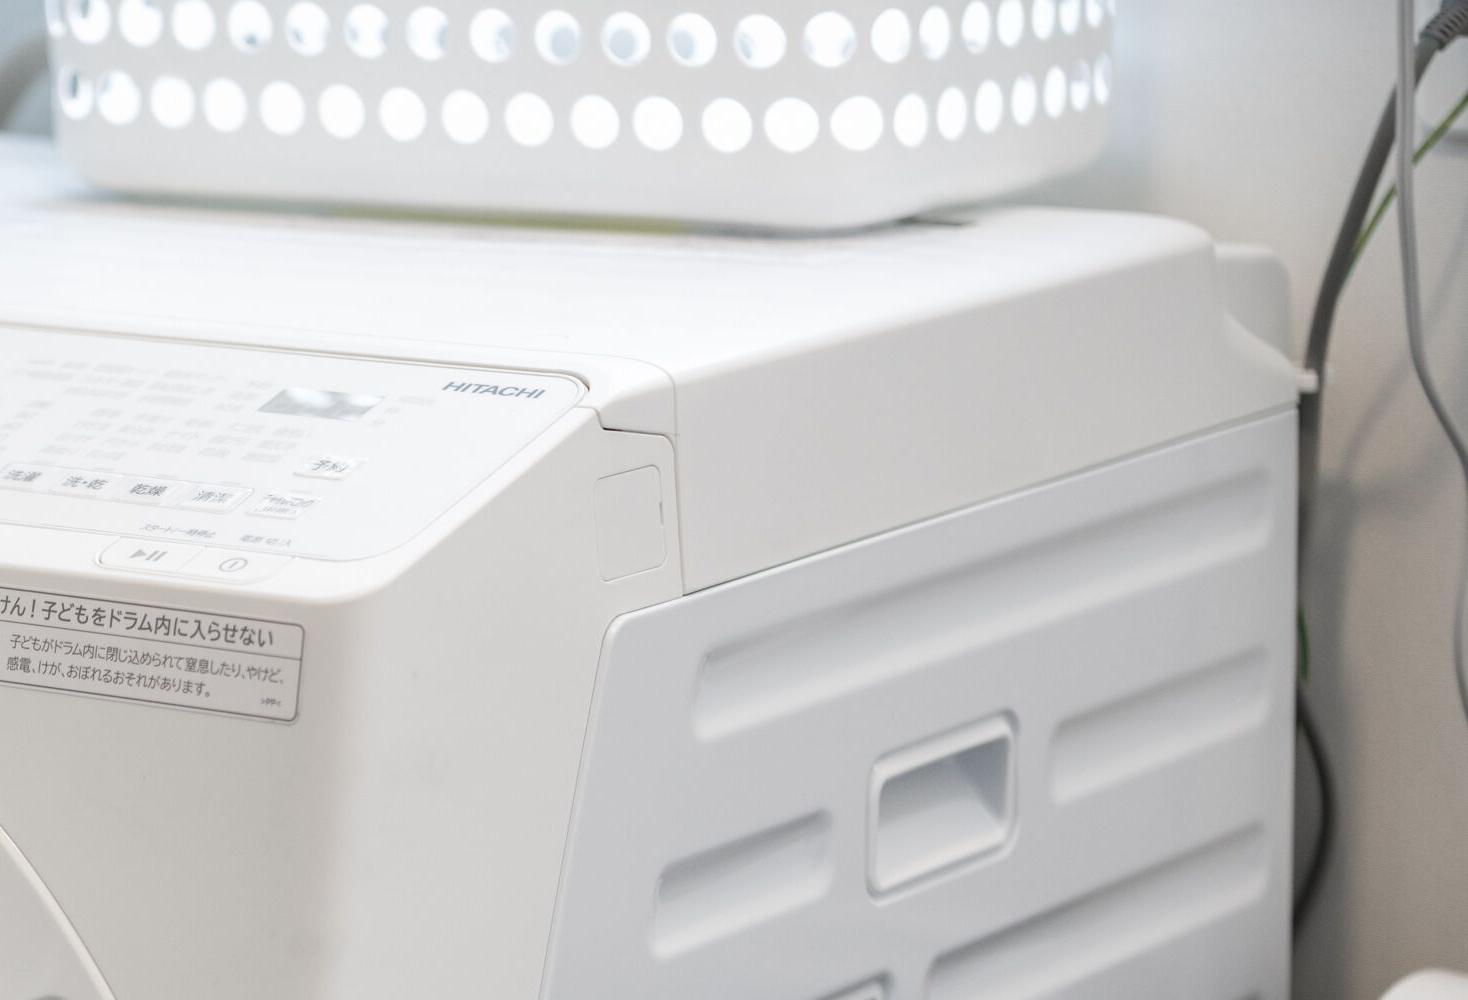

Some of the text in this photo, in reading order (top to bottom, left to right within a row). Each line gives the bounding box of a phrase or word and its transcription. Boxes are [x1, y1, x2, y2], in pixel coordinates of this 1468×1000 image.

[442, 381, 546, 399] HITACHI
[6, 656, 211, 698] 感電、けが、おぼれるおそれがあります。
[9, 633, 284, 685] 子どもがドラム内に閉じ込められて窒息したり、やけど、
